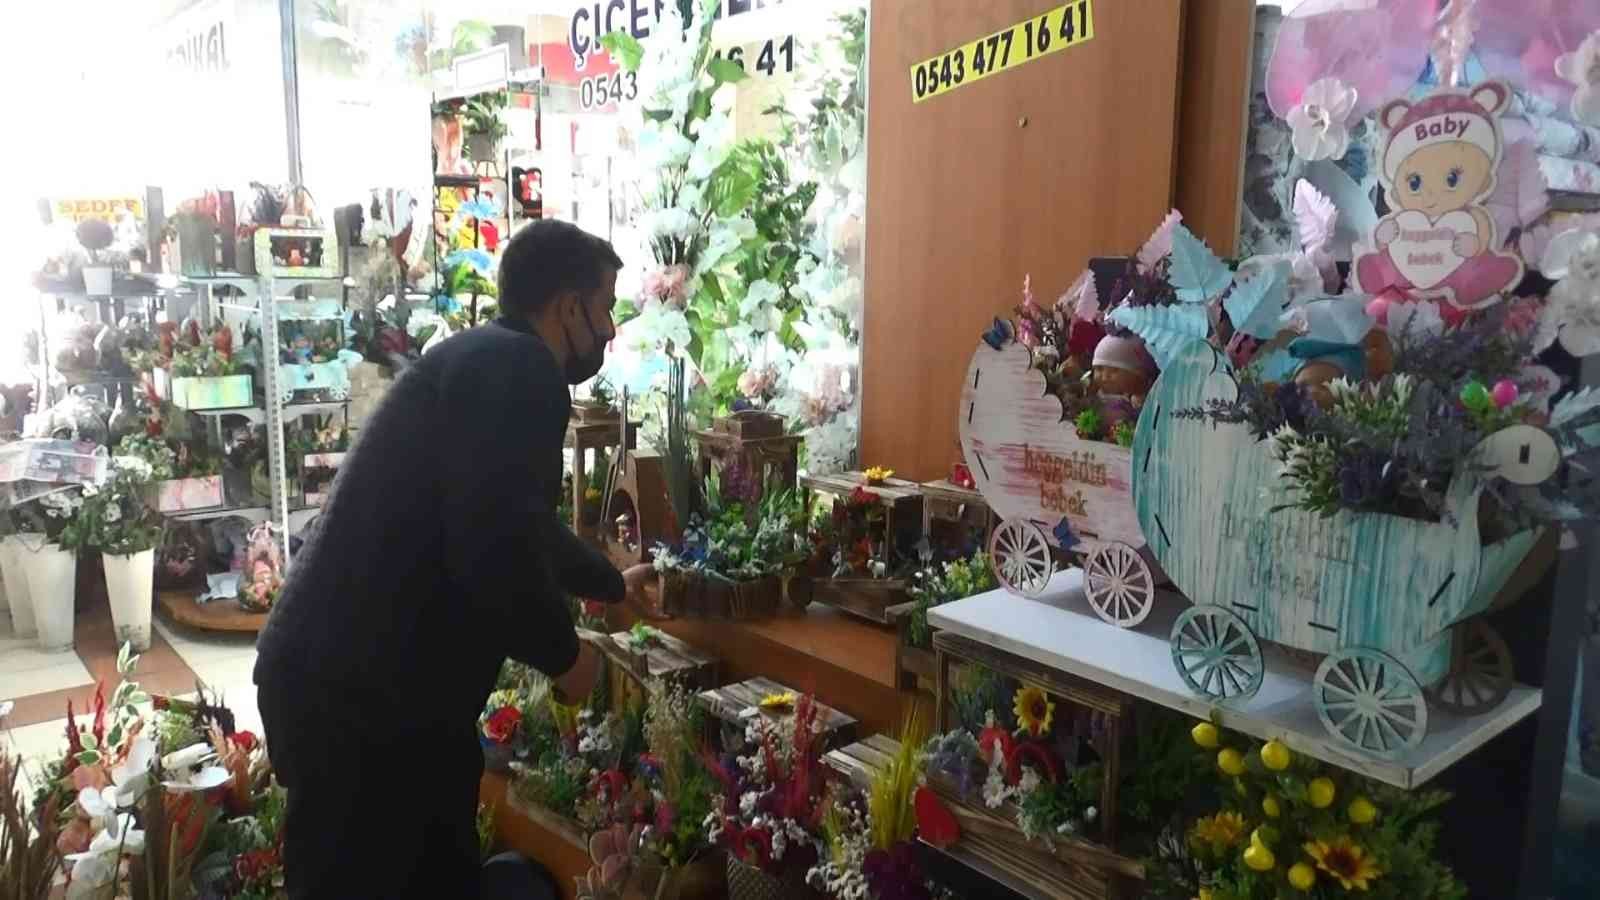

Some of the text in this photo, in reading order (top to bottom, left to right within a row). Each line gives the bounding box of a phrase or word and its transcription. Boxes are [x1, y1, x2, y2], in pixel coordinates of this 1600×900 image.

[580, 71, 638, 106] 0543
[756, 32, 793, 76] 41
[915, 1, 1087, 98] 0543 477 16 41
[1415, 116, 1470, 142] Baby
